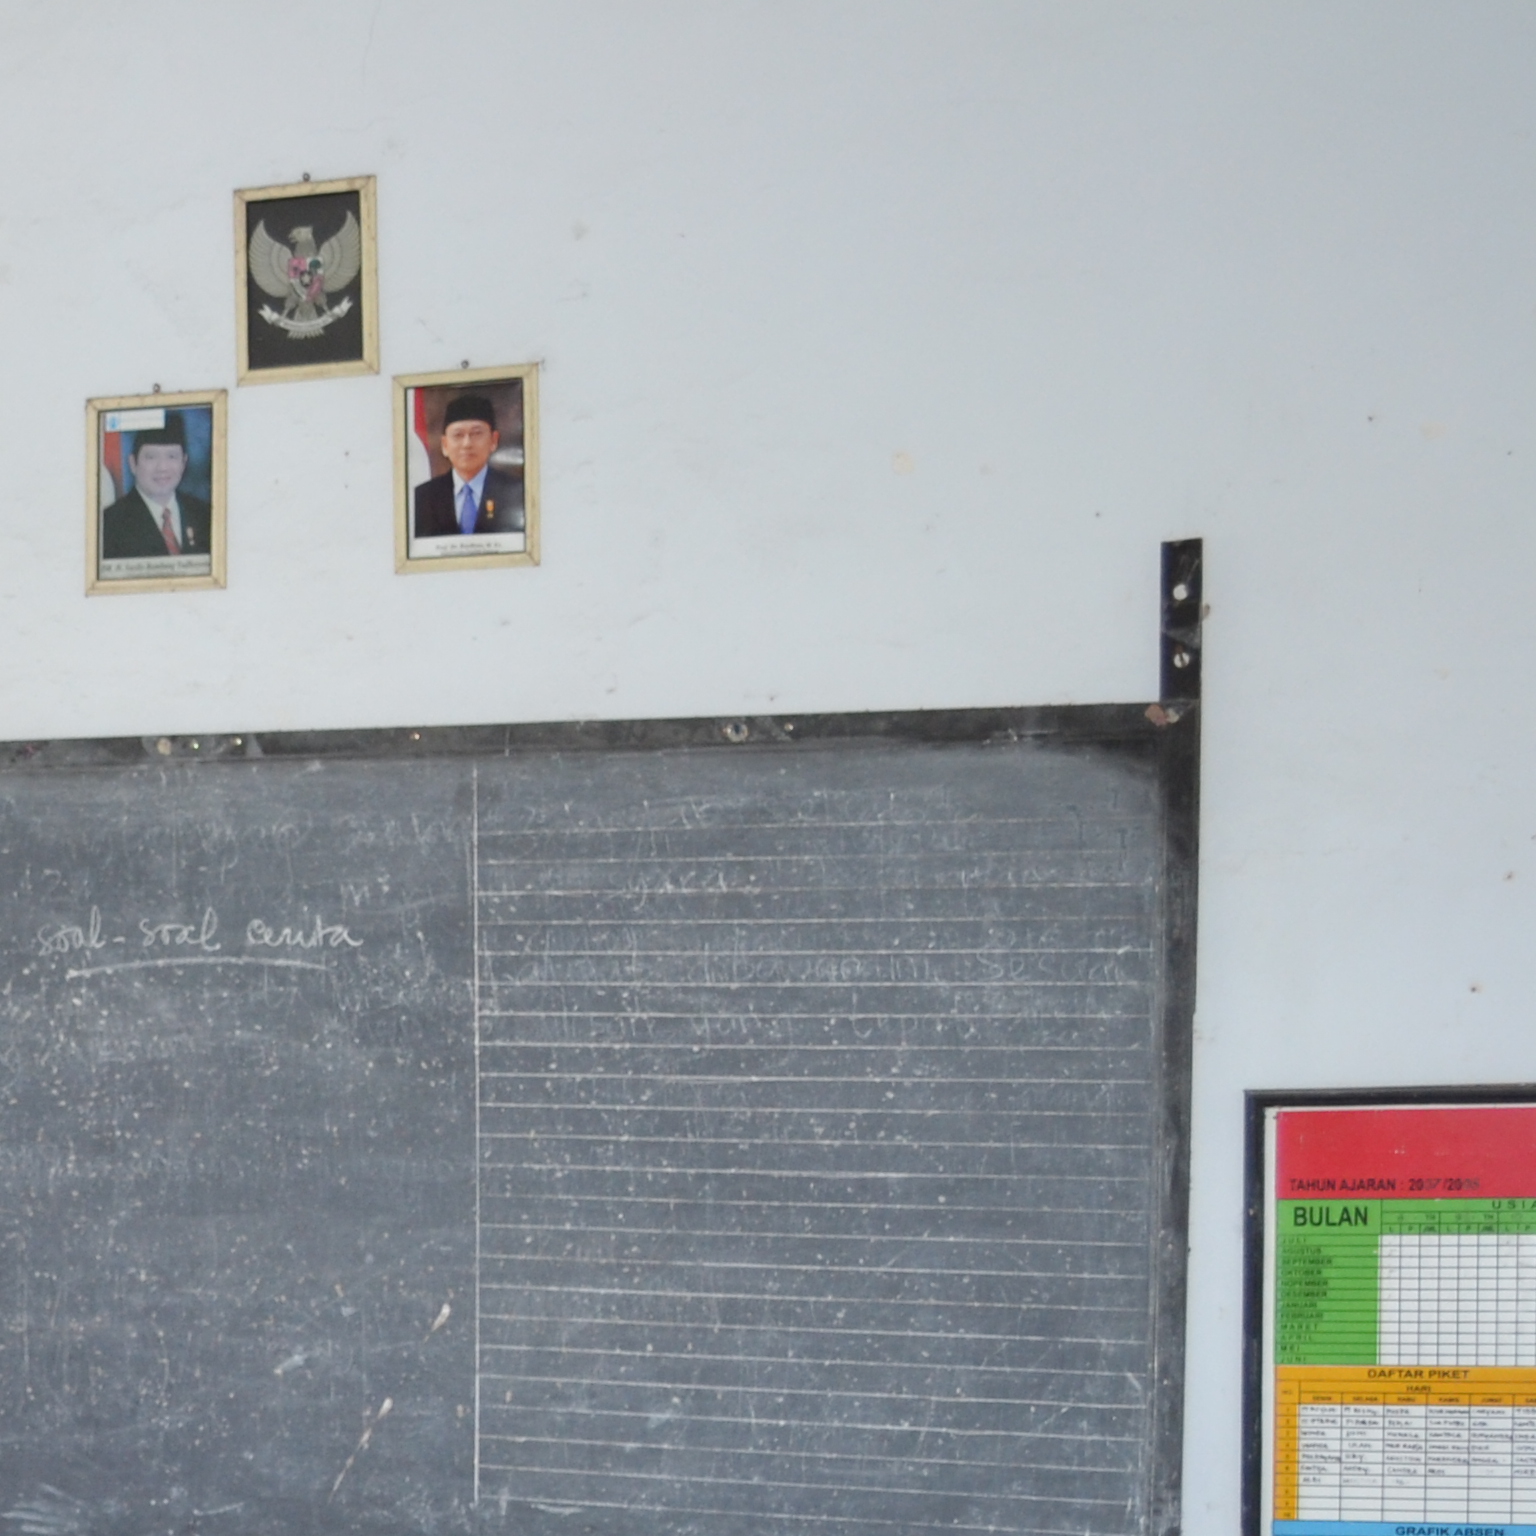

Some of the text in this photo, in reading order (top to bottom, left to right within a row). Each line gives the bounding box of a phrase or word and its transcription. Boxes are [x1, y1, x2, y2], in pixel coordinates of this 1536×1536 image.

[1290, 1178, 1336, 1191] TAHUN
[1338, 1178, 1397, 1191] AJARAN
[1293, 1205, 1368, 1227] BULAN
[1367, 1368, 1470, 1379] DAFTAR PIKET
[1395, 1526, 1448, 1536] GRAFIK
